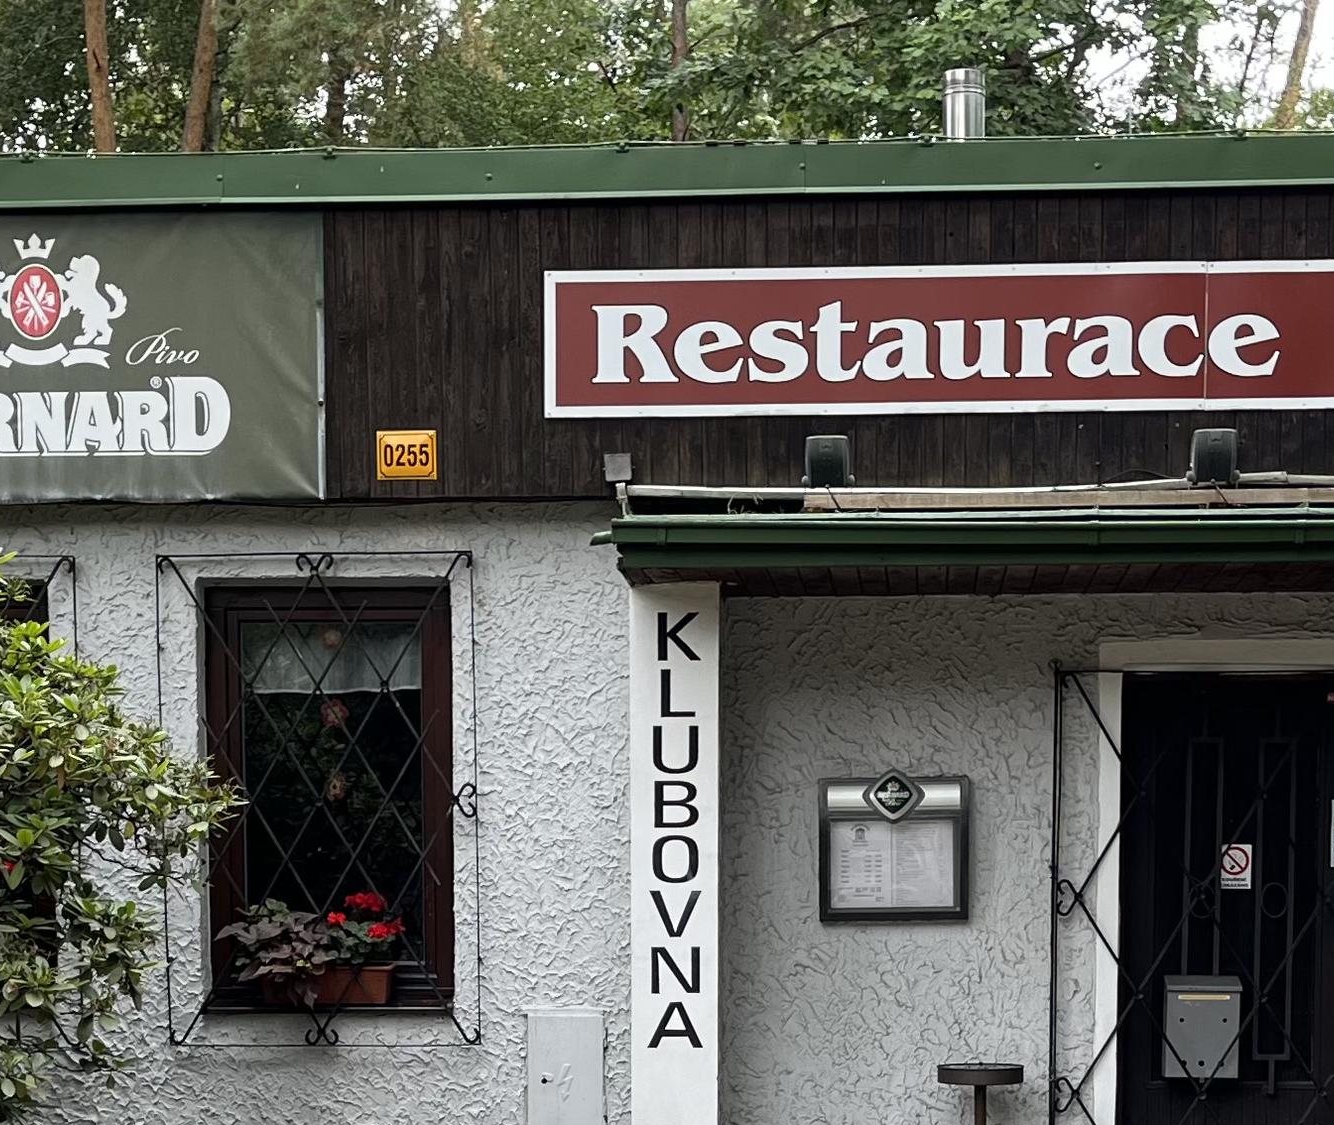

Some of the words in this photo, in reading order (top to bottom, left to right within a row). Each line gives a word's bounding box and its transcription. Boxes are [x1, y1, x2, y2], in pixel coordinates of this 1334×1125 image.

[125, 327, 201, 367] Pivo
[590, 299, 1282, 386] Restaurace
[384, 443, 430, 468] 0255
[647, 611, 704, 1049] KLUBOVNA
